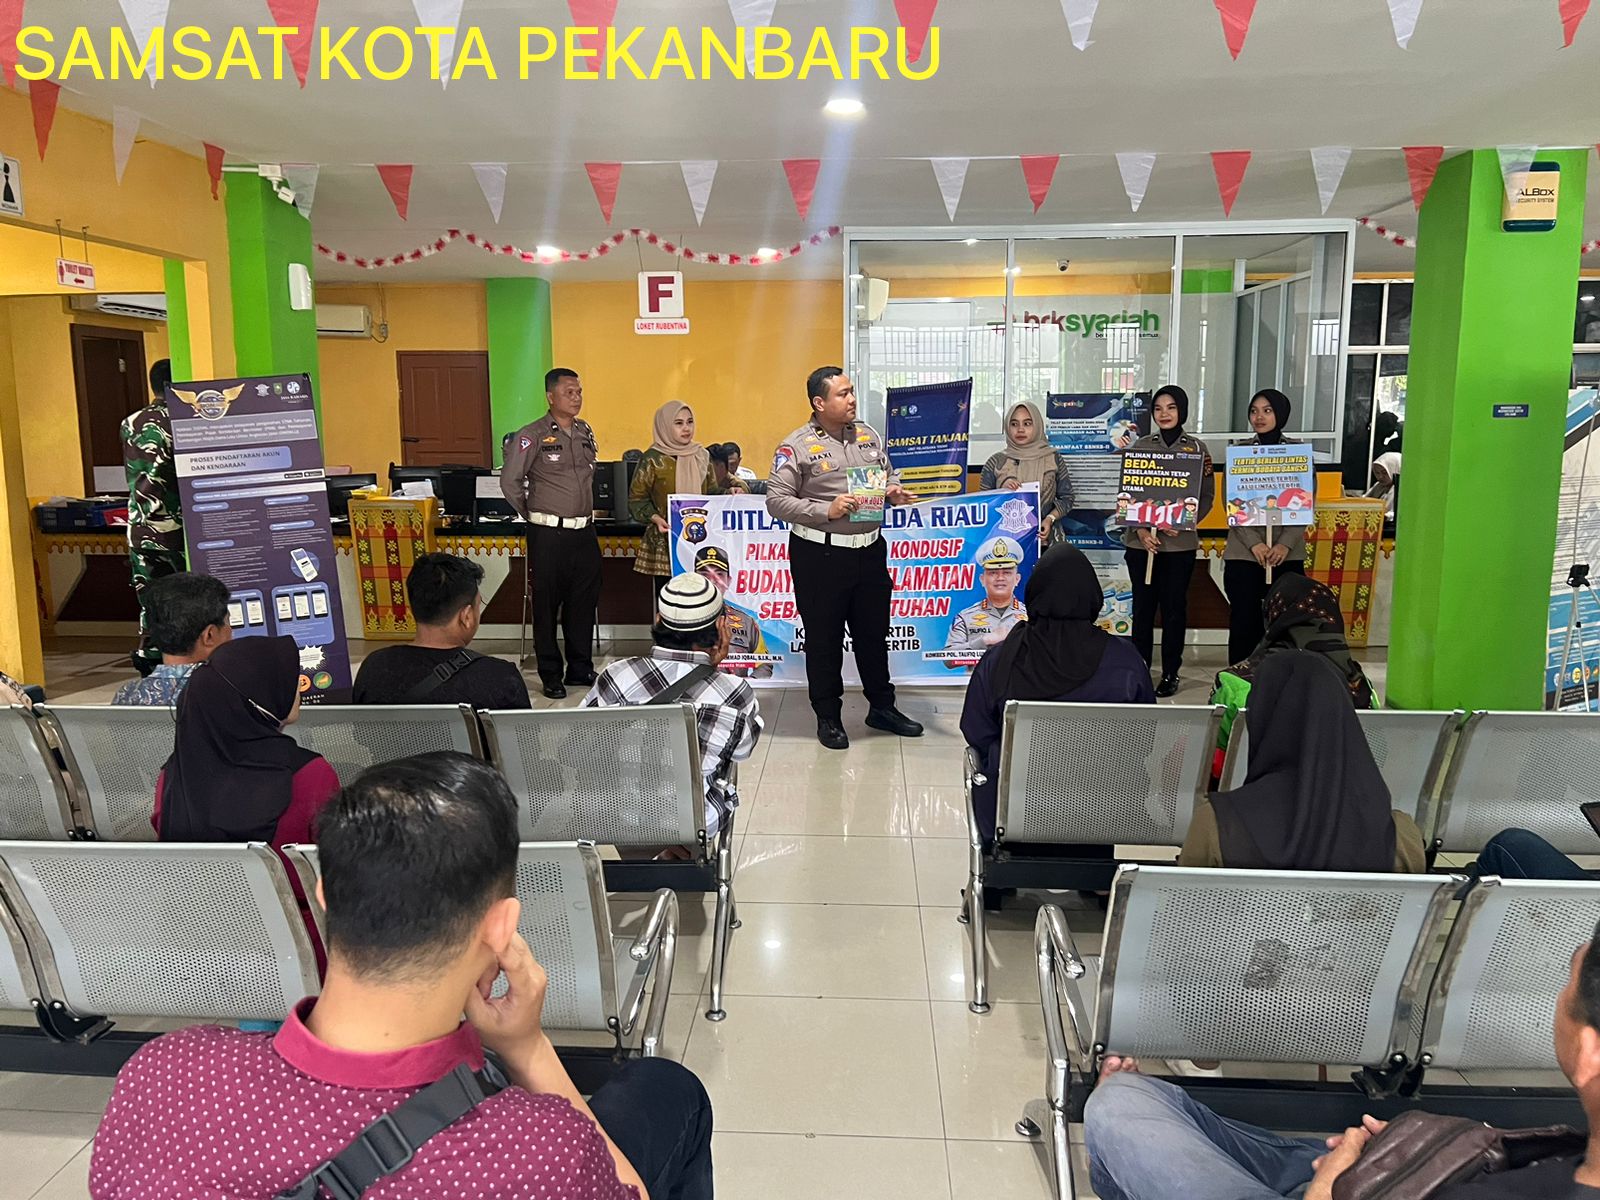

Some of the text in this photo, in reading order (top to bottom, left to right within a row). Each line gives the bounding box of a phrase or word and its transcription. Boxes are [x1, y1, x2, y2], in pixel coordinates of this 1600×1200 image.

[648, 276, 674, 312] F
[656, 322, 687, 330] RUBENTINA
[887, 432, 969, 448] SAMSAT TANJAK
[215, 453, 261, 461] PENDAFTARAN
[1233, 455, 1308, 465] TERTIB BERLALU LINTAS
[206, 462, 246, 470] KENDARAAN
[1124, 459, 1164, 470] BEDA..
[1255, 465, 1281, 474] BUDAYA
[1122, 475, 1188, 488] PRIORITAS
[931, 504, 987, 528] RIAU
[890, 539, 963, 558] KONDUSIF
[736, 569, 795, 594] BUDAY
[890, 598, 950, 617] TUHAN
